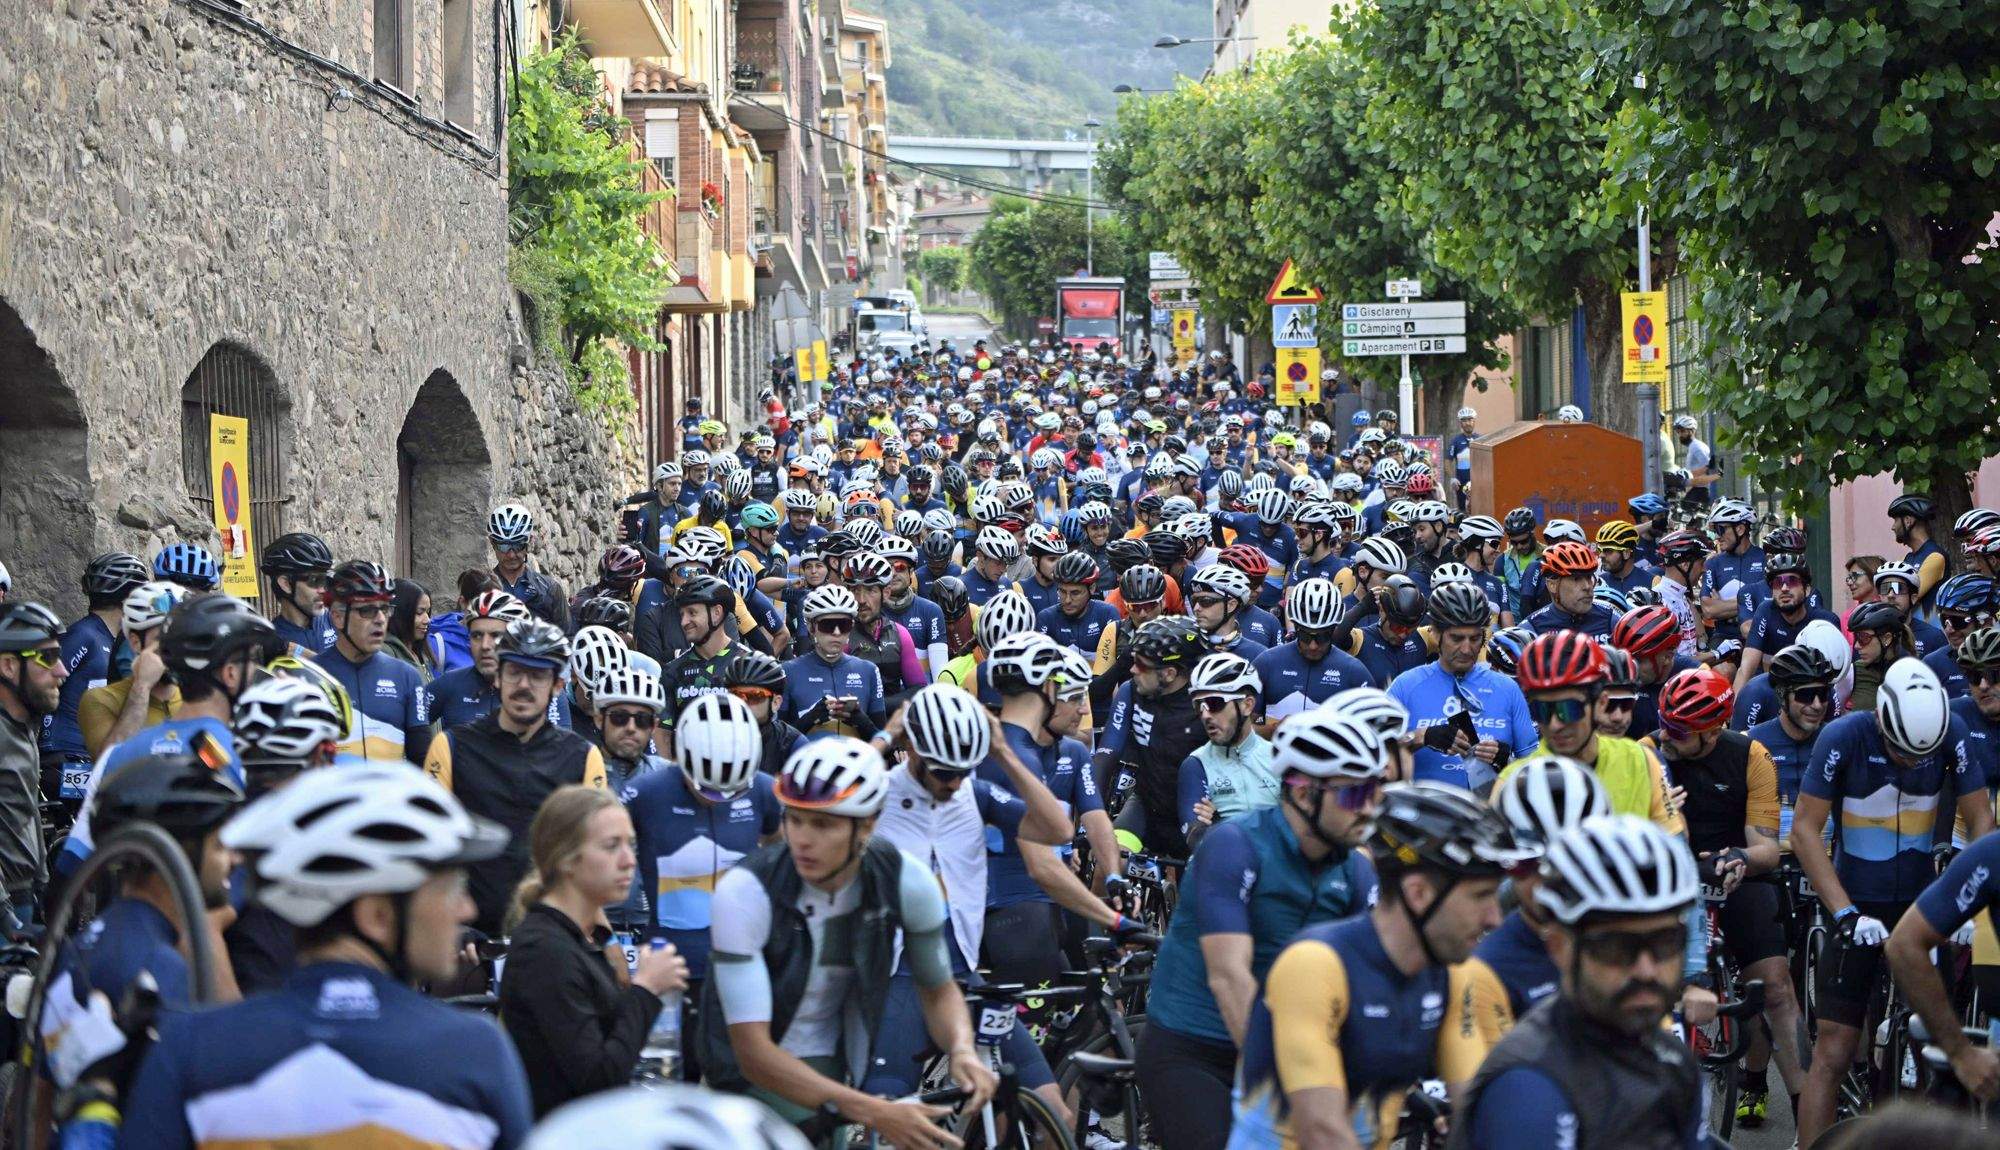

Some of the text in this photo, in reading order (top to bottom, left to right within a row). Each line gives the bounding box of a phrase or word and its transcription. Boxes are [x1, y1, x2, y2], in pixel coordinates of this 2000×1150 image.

[1360, 307, 1412, 318] Gisclareny
[1360, 323, 1402, 335] Càmping
[1361, 342, 1417, 353] Aparcament
[72, 646, 88, 671] CIMS
[1103, 639, 1111, 662] 4CIMS
[1113, 701, 1127, 730] 4CIMS
[1970, 731, 1987, 739] tactic
[1823, 749, 1842, 783] 4CIMS
[1868, 755, 1888, 765] tactic
[1081, 763, 1096, 796] tactic
[1129, 866, 1158, 880] 574
[1955, 866, 1990, 913] 4CIMS
